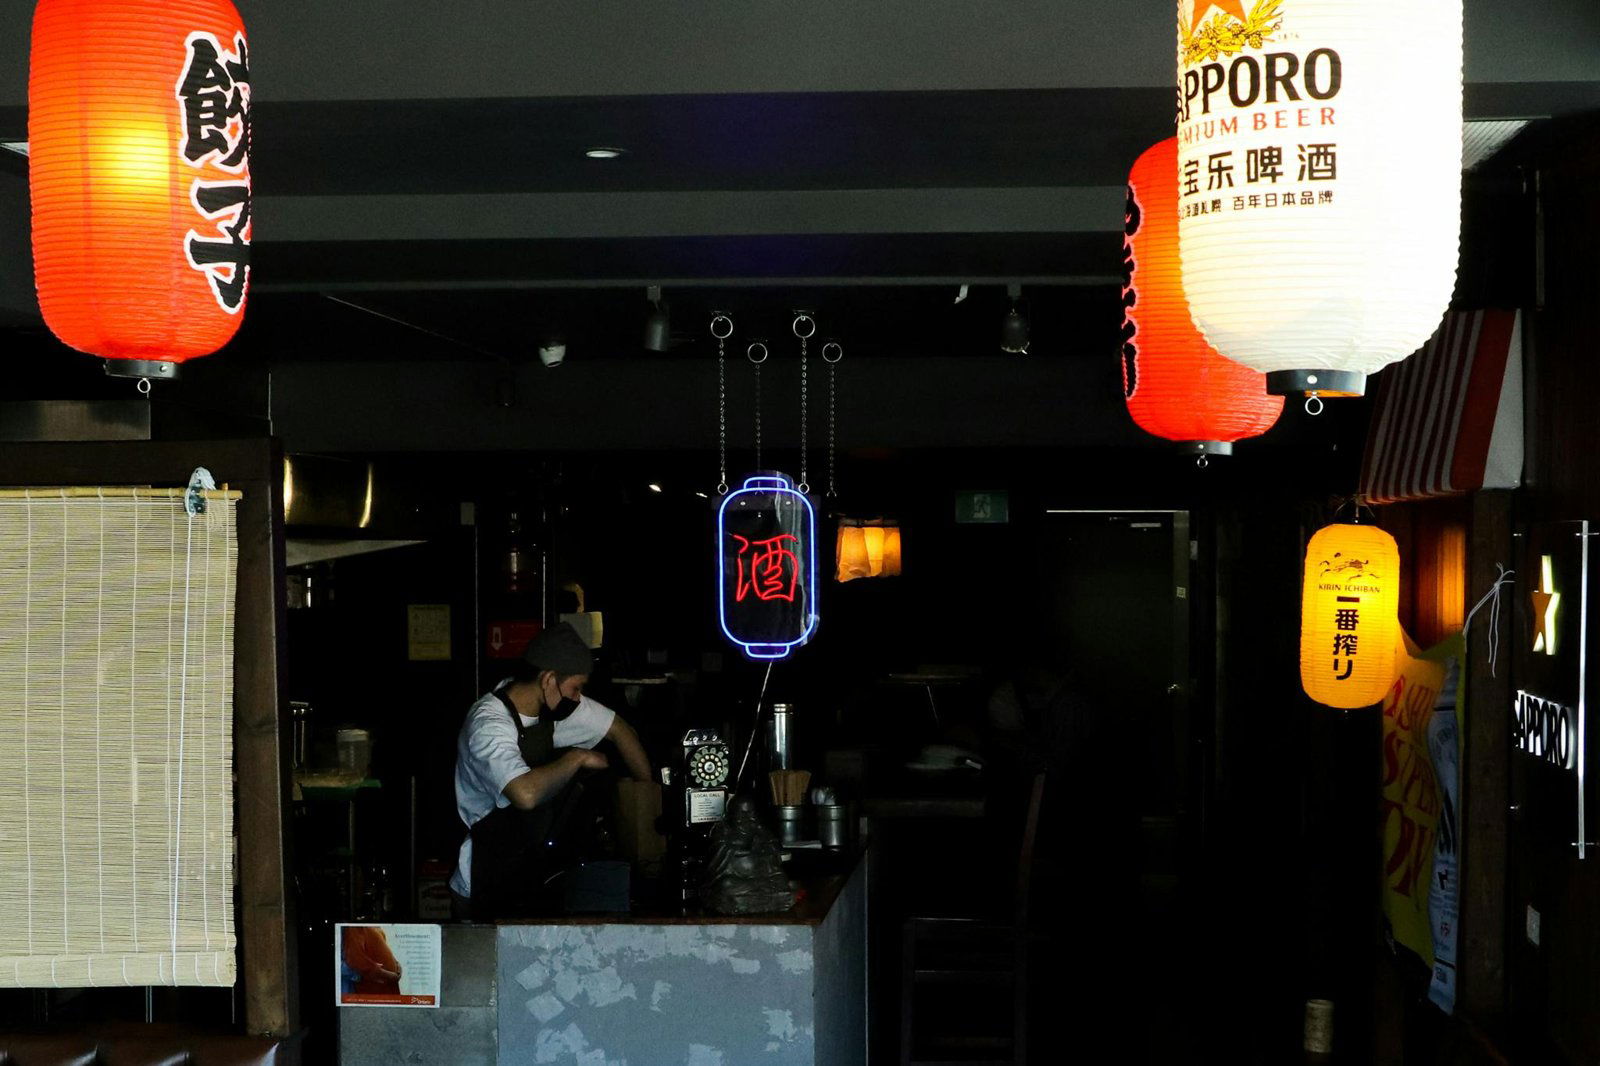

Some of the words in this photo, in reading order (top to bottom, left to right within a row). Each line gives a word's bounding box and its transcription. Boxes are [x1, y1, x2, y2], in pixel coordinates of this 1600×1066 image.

[1177, 48, 1341, 122] APPORO
[1180, 116, 1238, 145] MIUM
[1252, 107, 1335, 131] BEER
[1181, 143, 1337, 197] 宝乐啤酒
[1233, 190, 1334, 211] 百年日本品牌
[730, 533, 799, 602] 酒
[1318, 583, 1341, 591] KIRIN
[1344, 585, 1380, 593] ICHIBAN
[1333, 596, 1360, 680] 一番搾り
